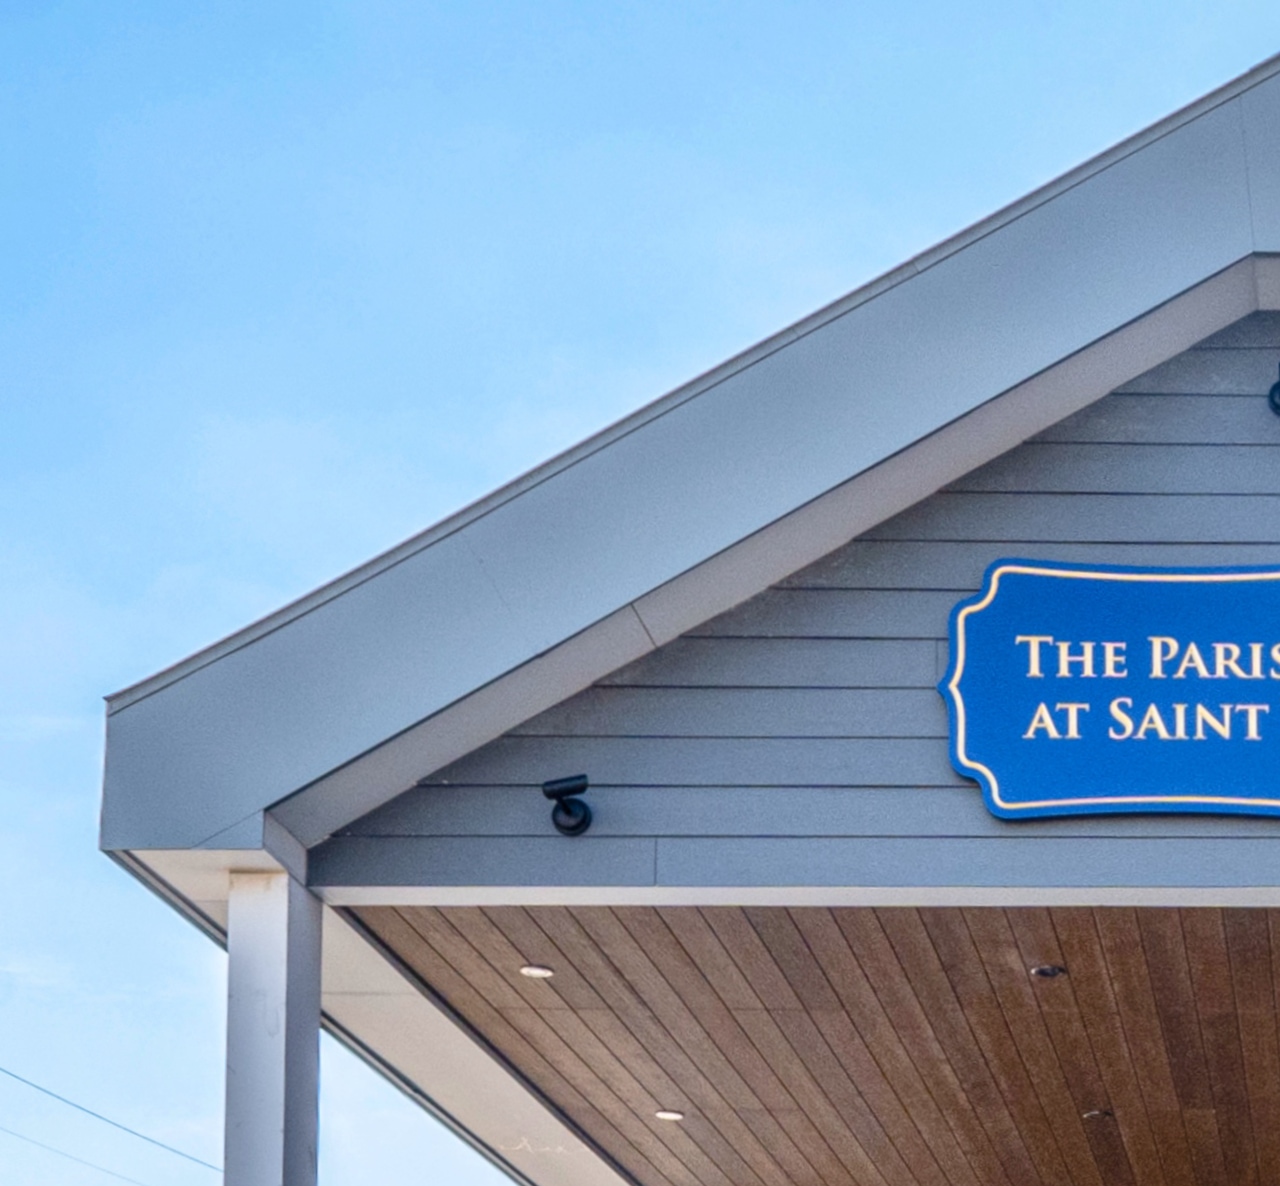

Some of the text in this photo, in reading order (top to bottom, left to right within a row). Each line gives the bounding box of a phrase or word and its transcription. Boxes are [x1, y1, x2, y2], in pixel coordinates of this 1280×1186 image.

[1015, 635, 1128, 678] THE
[1023, 702, 1090, 739] AT
[1108, 697, 1270, 740] SAINT
